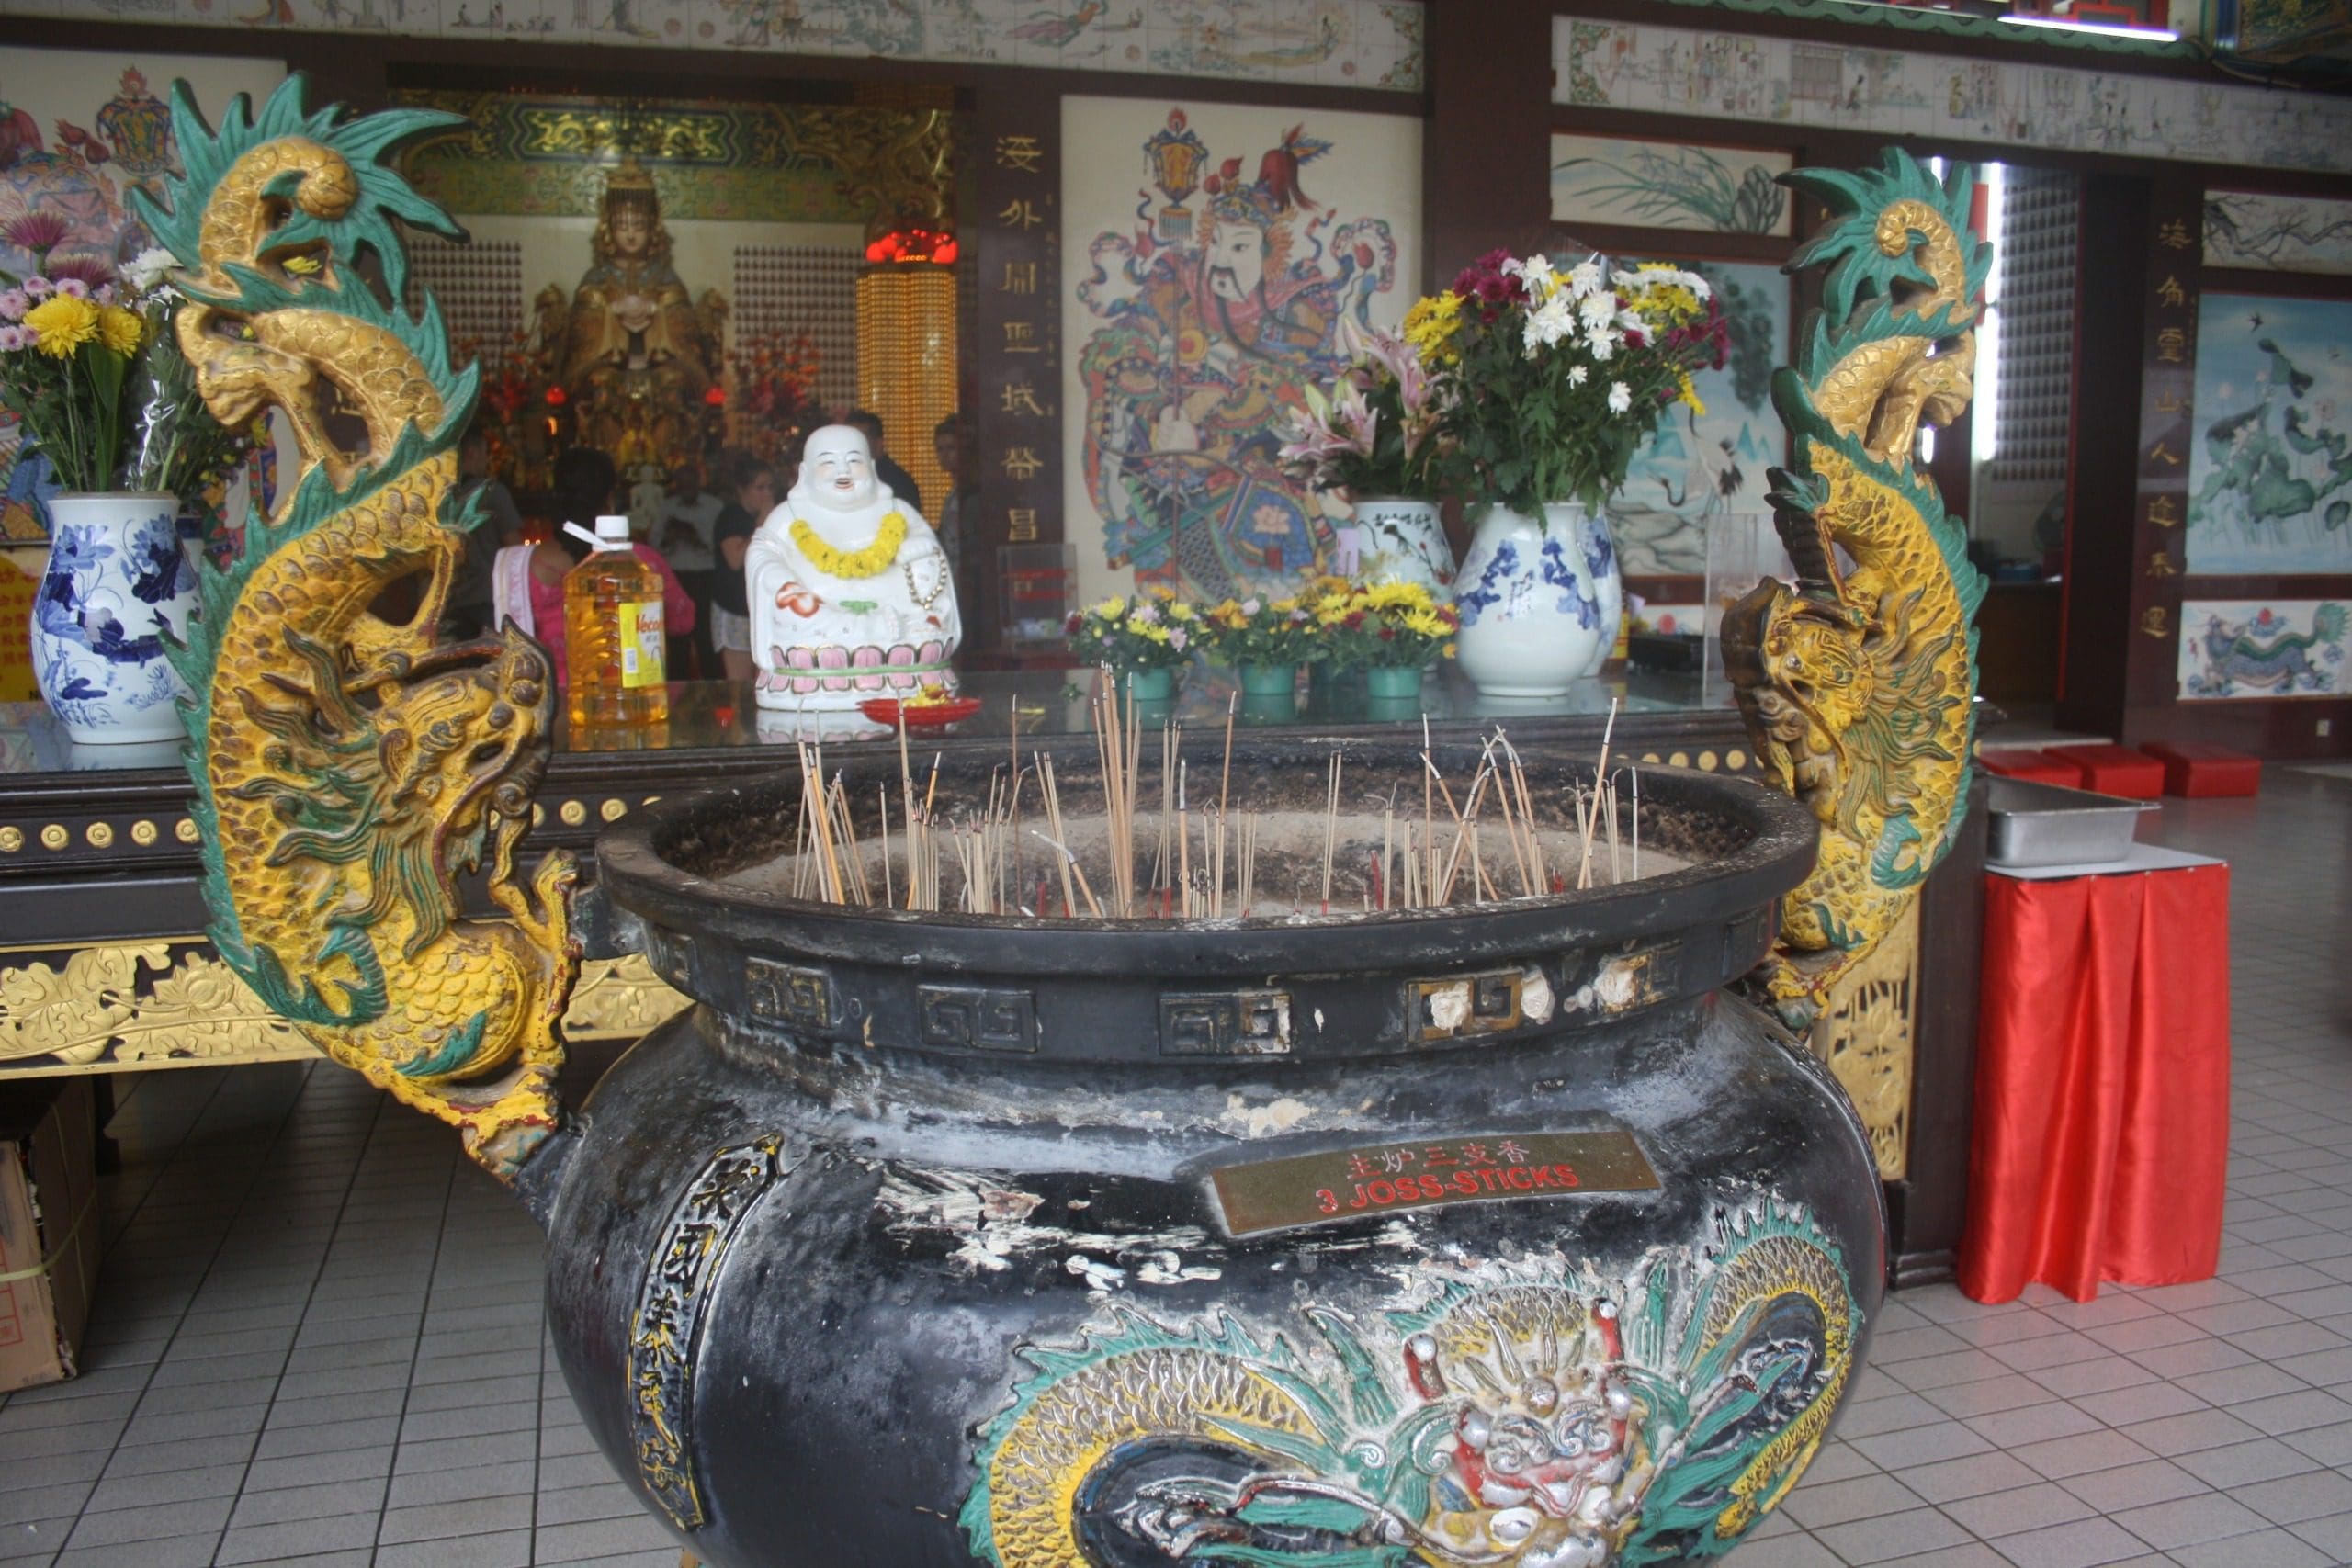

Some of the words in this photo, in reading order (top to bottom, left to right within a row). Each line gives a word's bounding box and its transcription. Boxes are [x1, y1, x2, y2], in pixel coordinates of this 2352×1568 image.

[1347, 1140, 1530, 1180] 主炉三支香
[1315, 1189, 1339, 1213] 3
[1349, 1164, 1580, 1209] JOSS-STICKS
